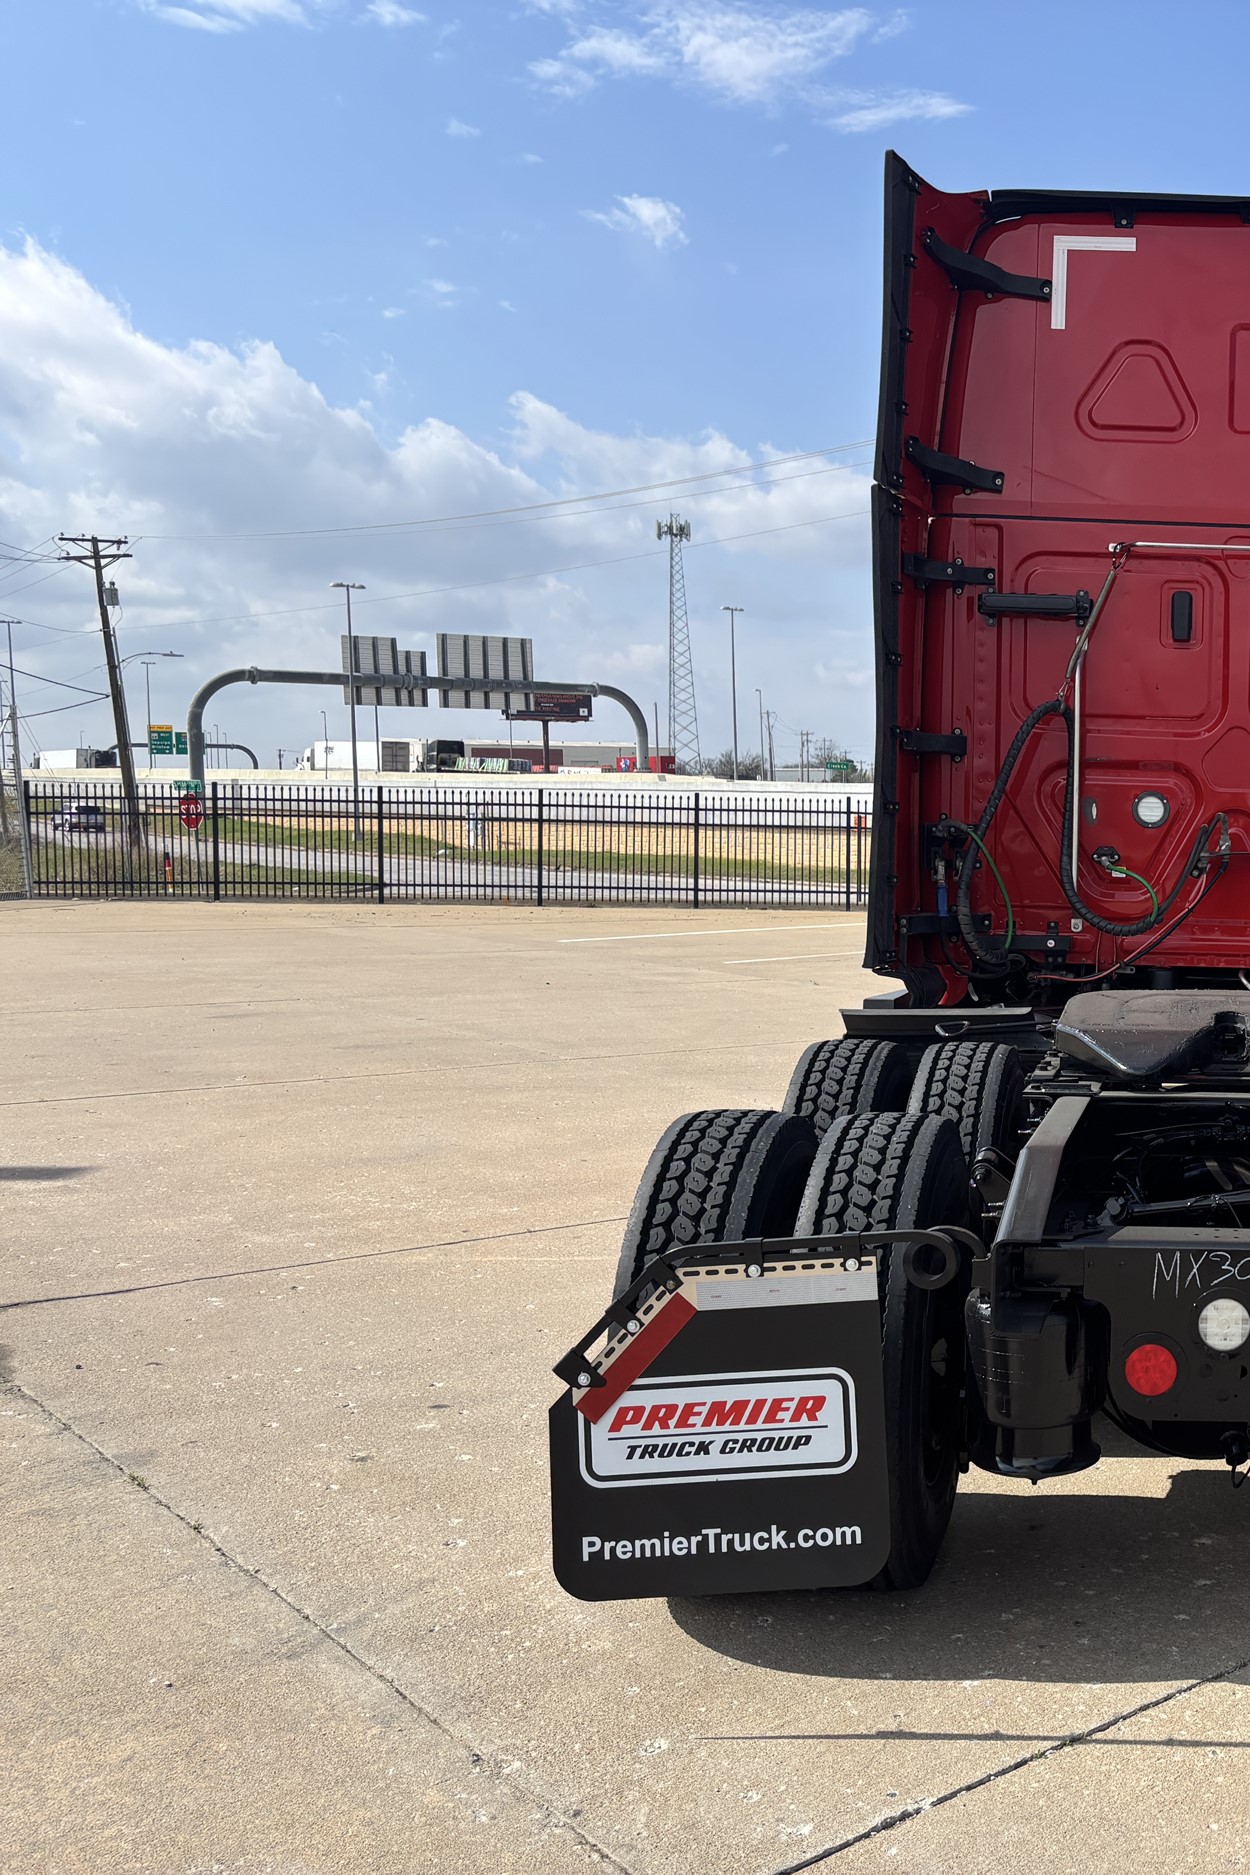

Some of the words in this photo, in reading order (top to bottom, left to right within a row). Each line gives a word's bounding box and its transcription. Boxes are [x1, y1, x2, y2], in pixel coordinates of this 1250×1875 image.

[181, 804, 201, 818] SOP
[608, 1395, 827, 1433] PREMIER
[625, 1439, 715, 1461] TRUCK
[719, 1434, 813, 1455] GROUP
[582, 1524, 862, 1562] PremierTruck.com
